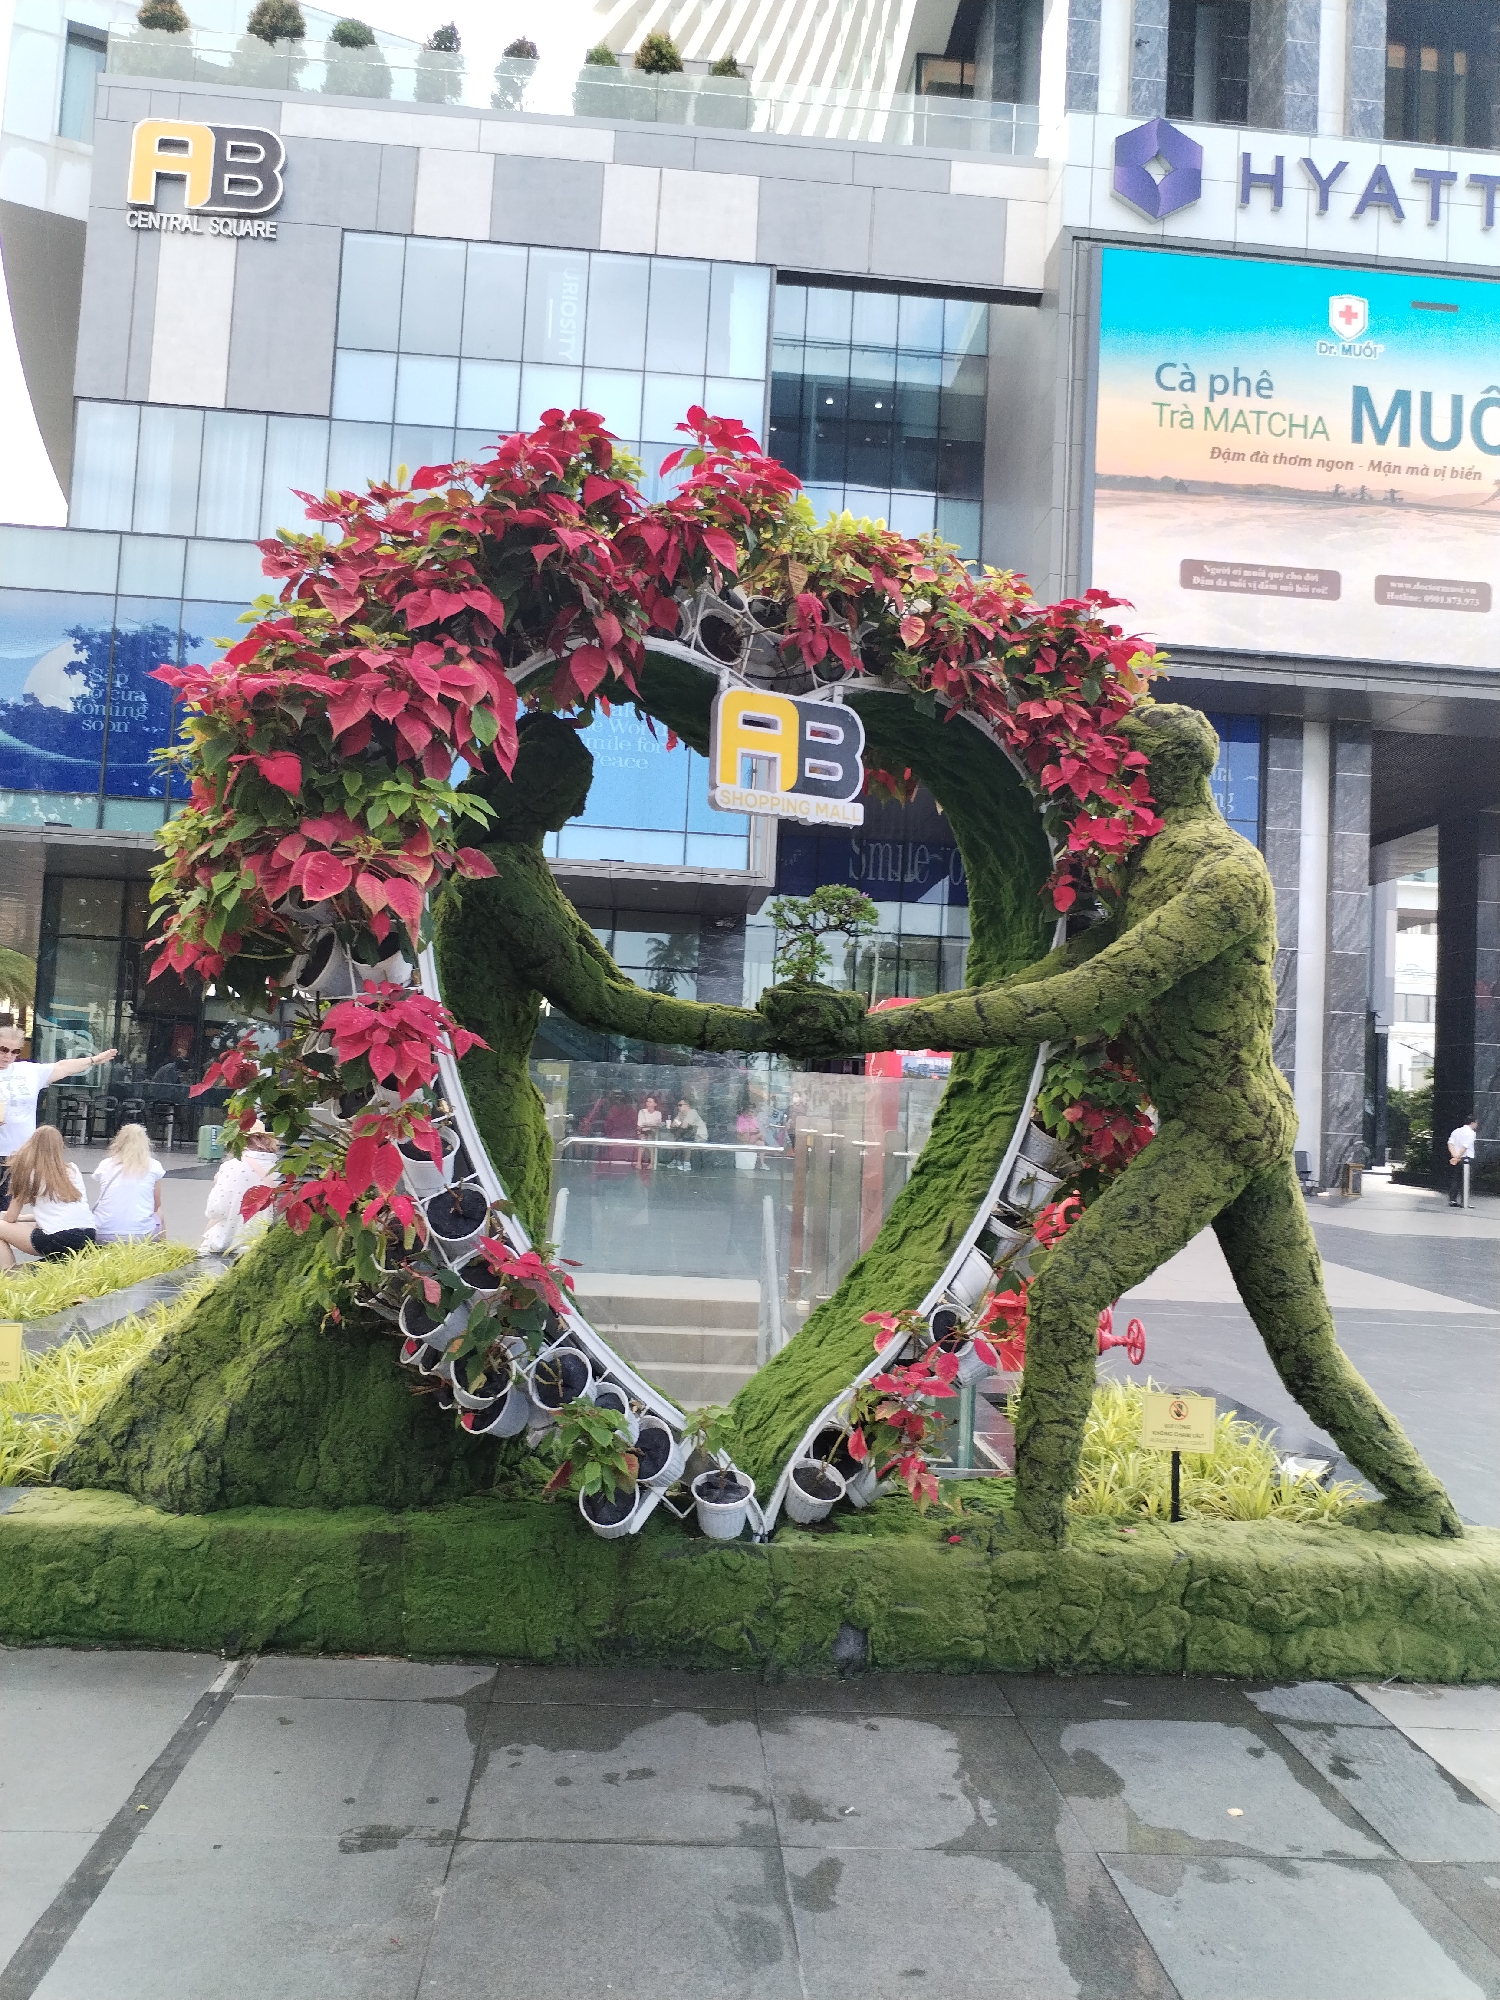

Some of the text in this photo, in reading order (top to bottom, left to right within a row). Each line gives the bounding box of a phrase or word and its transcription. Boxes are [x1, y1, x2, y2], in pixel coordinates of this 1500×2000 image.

[127, 117, 286, 215] AB
[1238, 152, 1500, 230] HYATT
[126, 211, 278, 239] CENTRAL SQUARE
[1318, 342, 1337, 355] Dr.
[1154, 361, 1274, 402] Cà phê
[1151, 401, 1331, 441] Trà MATCHA
[1209, 446, 1246, 464] Đậm
[1249, 450, 1270, 464] đà
[1273, 452, 1312, 468] thơm
[1316, 458, 1354, 473] ngon
[1367, 459, 1402, 477] Mặn
[1405, 463, 1430, 477] mà
[1433, 465, 1448, 482] vị
[1450, 464, 1483, 481] biển
[81, 719, 131, 733] soon
[582, 734, 633, 751] mile
[638, 736, 665, 754] for
[717, 686, 866, 802] AB
[720, 789, 861, 823] SHOPPING MALL
